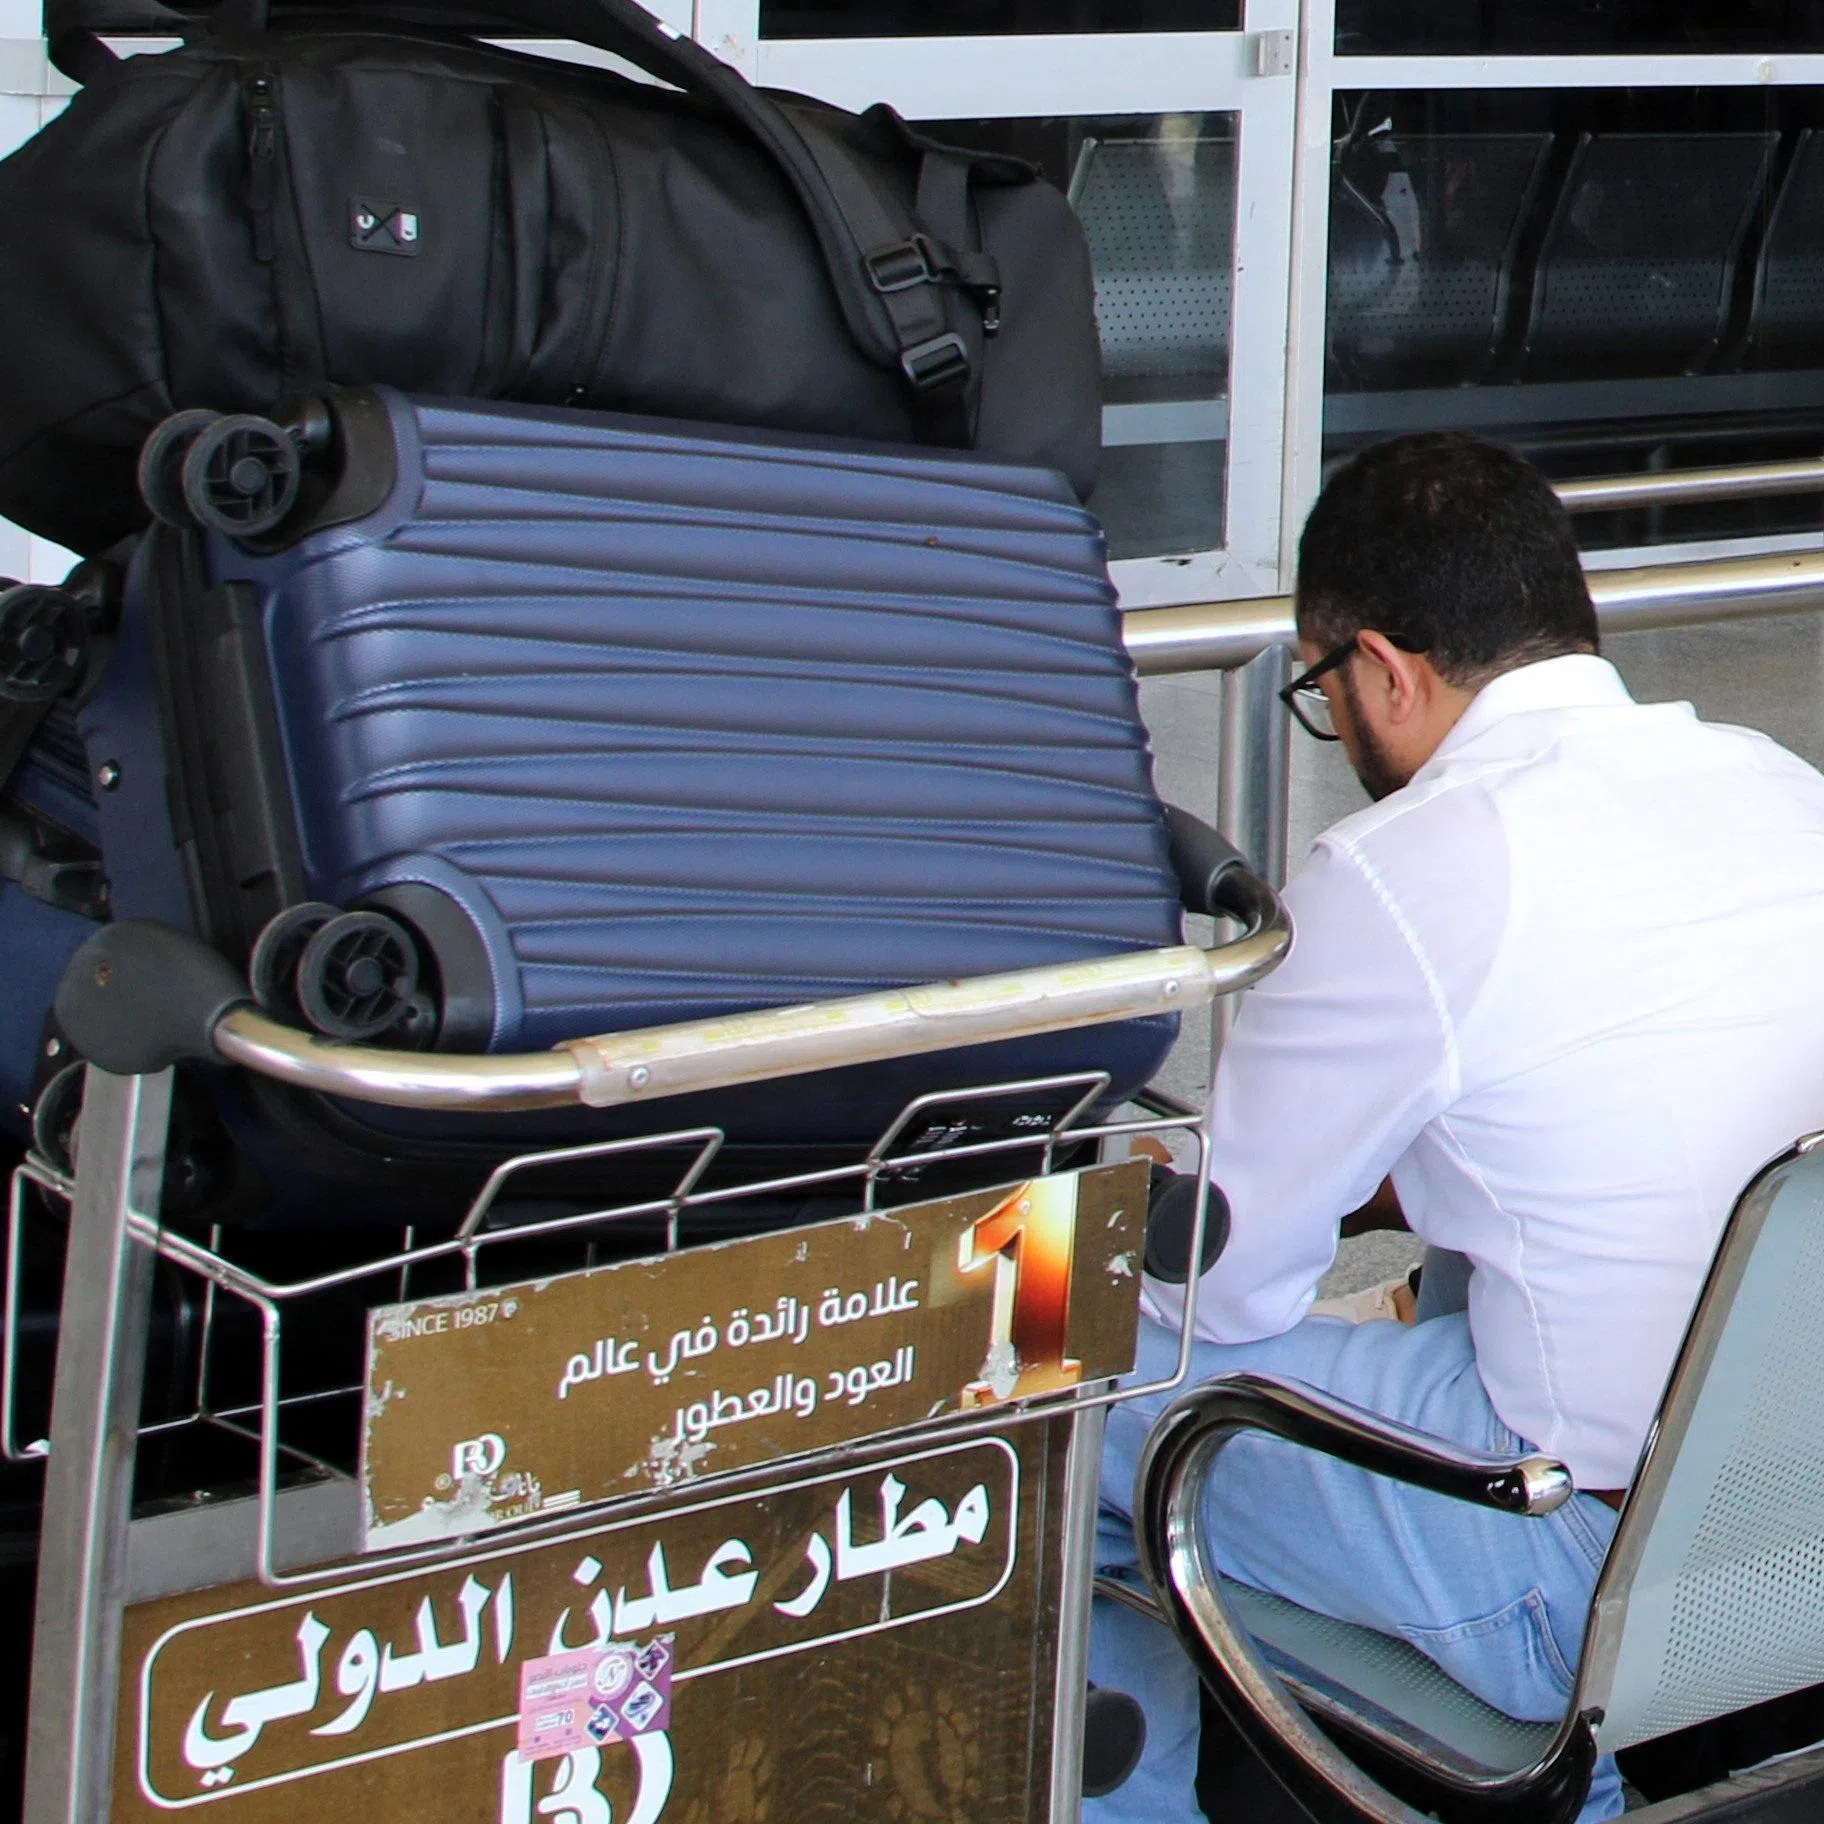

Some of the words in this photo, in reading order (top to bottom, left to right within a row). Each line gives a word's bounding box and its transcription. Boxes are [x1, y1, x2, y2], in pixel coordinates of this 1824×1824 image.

[386, 1311, 449, 1343] SINCE
[453, 1302, 499, 1330] 1987
[725, 1295, 811, 1345] رائدة
[818, 1275, 921, 1329] علامة
[558, 1338, 642, 1401] عالم
[646, 1314, 720, 1387] في
[824, 1345, 915, 1406] العود
[668, 1373, 818, 1446] والعطور
[773, 1472, 991, 1617] مطار
[548, 1537, 760, 1653] عدن
[183, 1571, 515, 1788] الدولي
